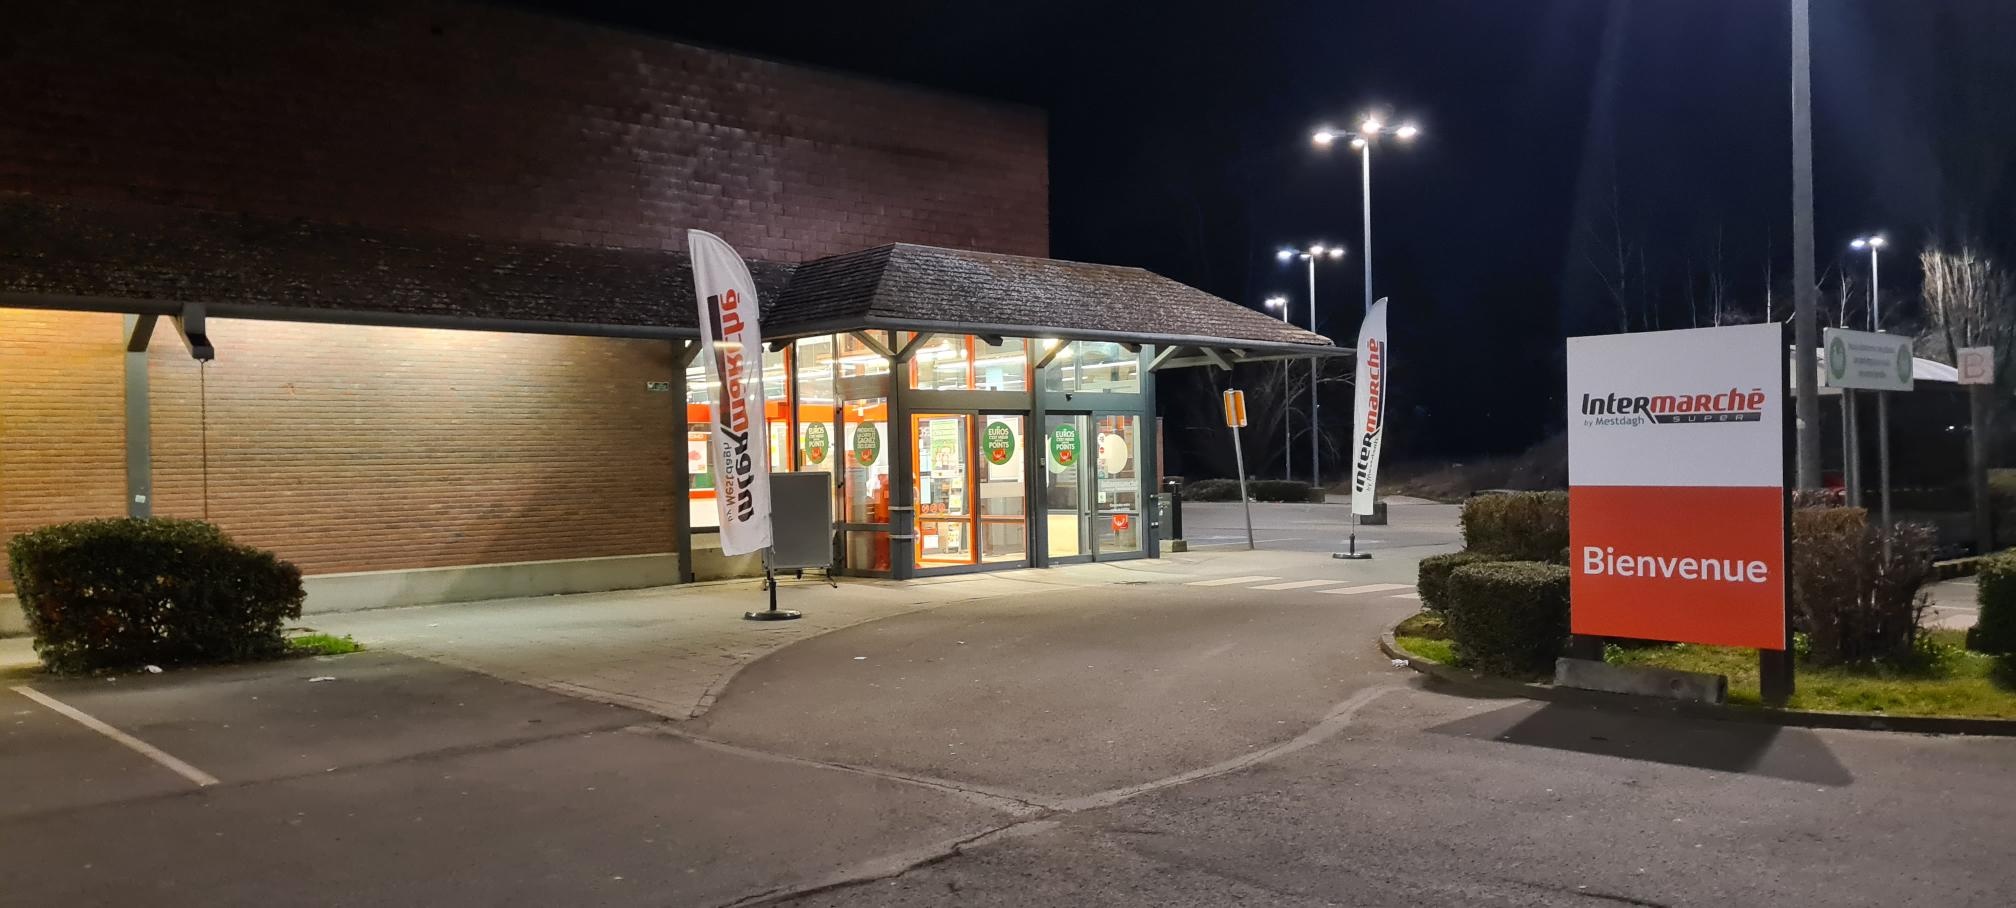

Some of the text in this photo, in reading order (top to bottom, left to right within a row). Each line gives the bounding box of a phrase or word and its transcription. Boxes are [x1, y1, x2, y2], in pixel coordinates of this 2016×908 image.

[1964, 352, 1985, 379] B
[1581, 388, 1766, 424] Intermarché
[1583, 416, 1645, 427] by Mestdagh
[1673, 414, 1744, 423] SUPER
[988, 428, 1009, 436] EUROS
[988, 441, 1010, 449] POINTS
[1583, 546, 1768, 583] Bienvenue
